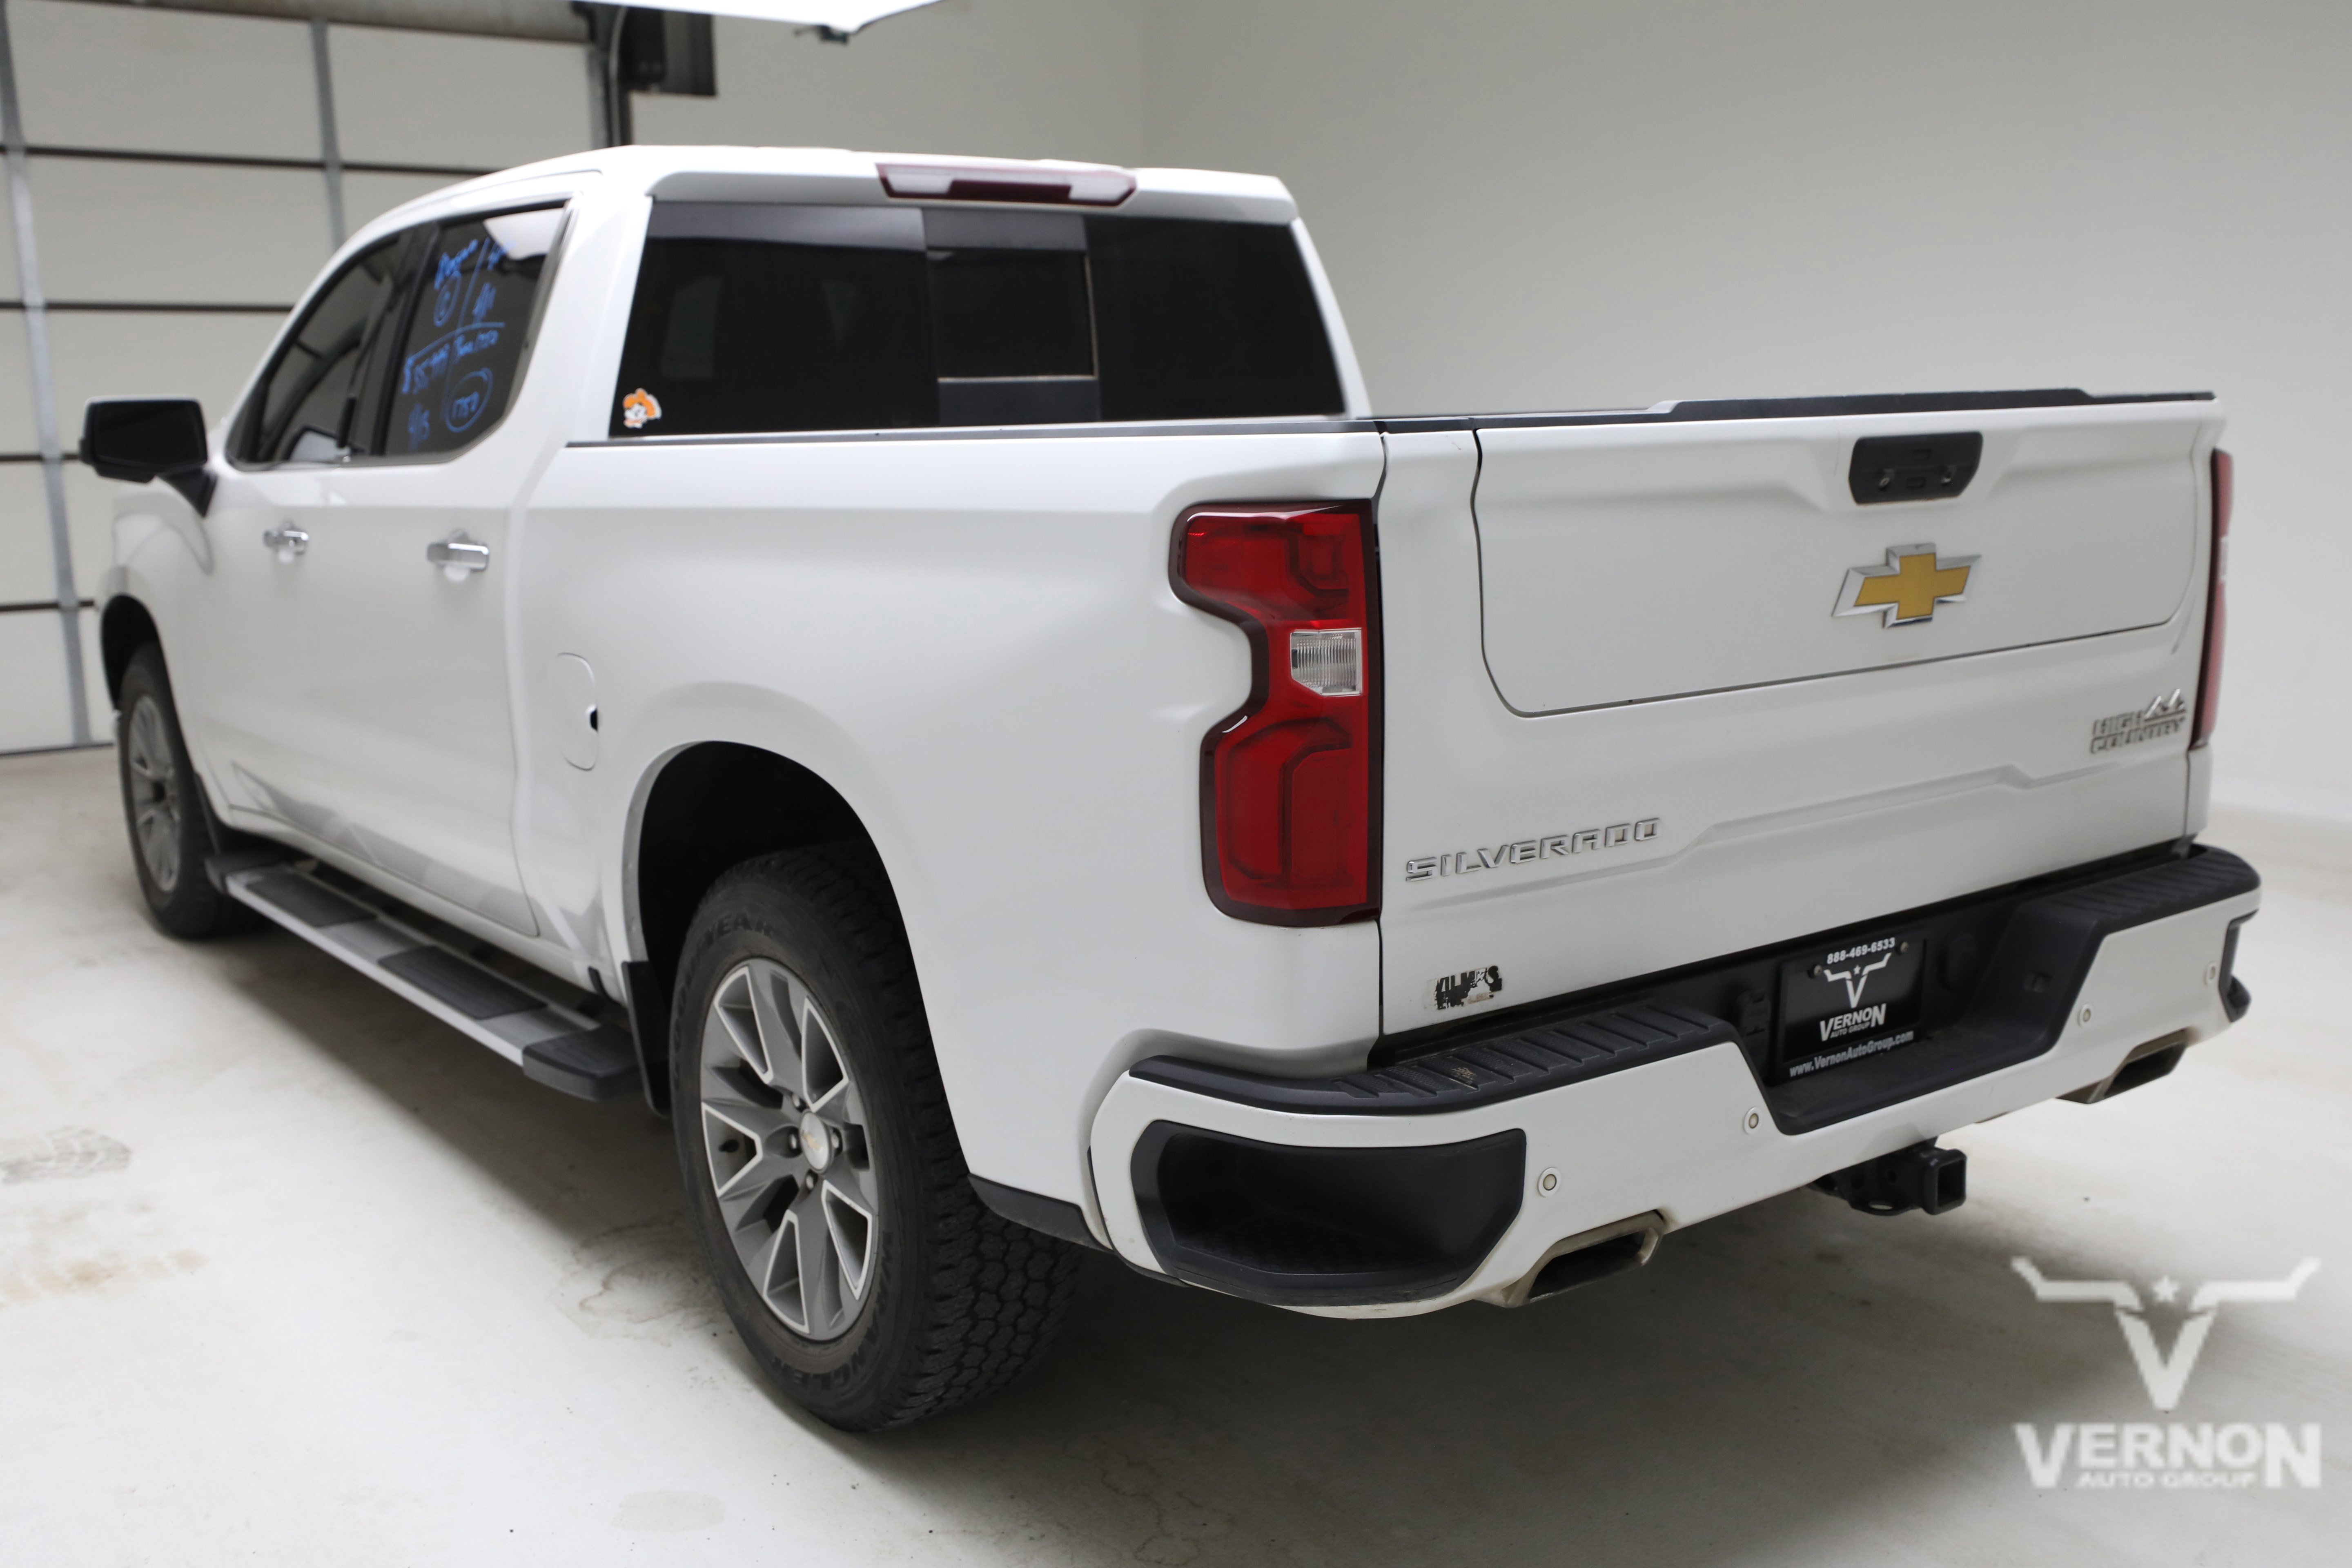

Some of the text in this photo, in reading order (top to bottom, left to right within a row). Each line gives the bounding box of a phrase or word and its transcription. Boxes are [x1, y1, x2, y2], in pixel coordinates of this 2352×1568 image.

[1405, 817, 1662, 882] SILVERADO
[1826, 937, 1896, 964] 888-469-6533
[1819, 1003, 1886, 1041] VERNON
[1829, 1028, 1848, 1038] AUTO
[1790, 1030, 1914, 1077] www.VernonAutoGroup.com
